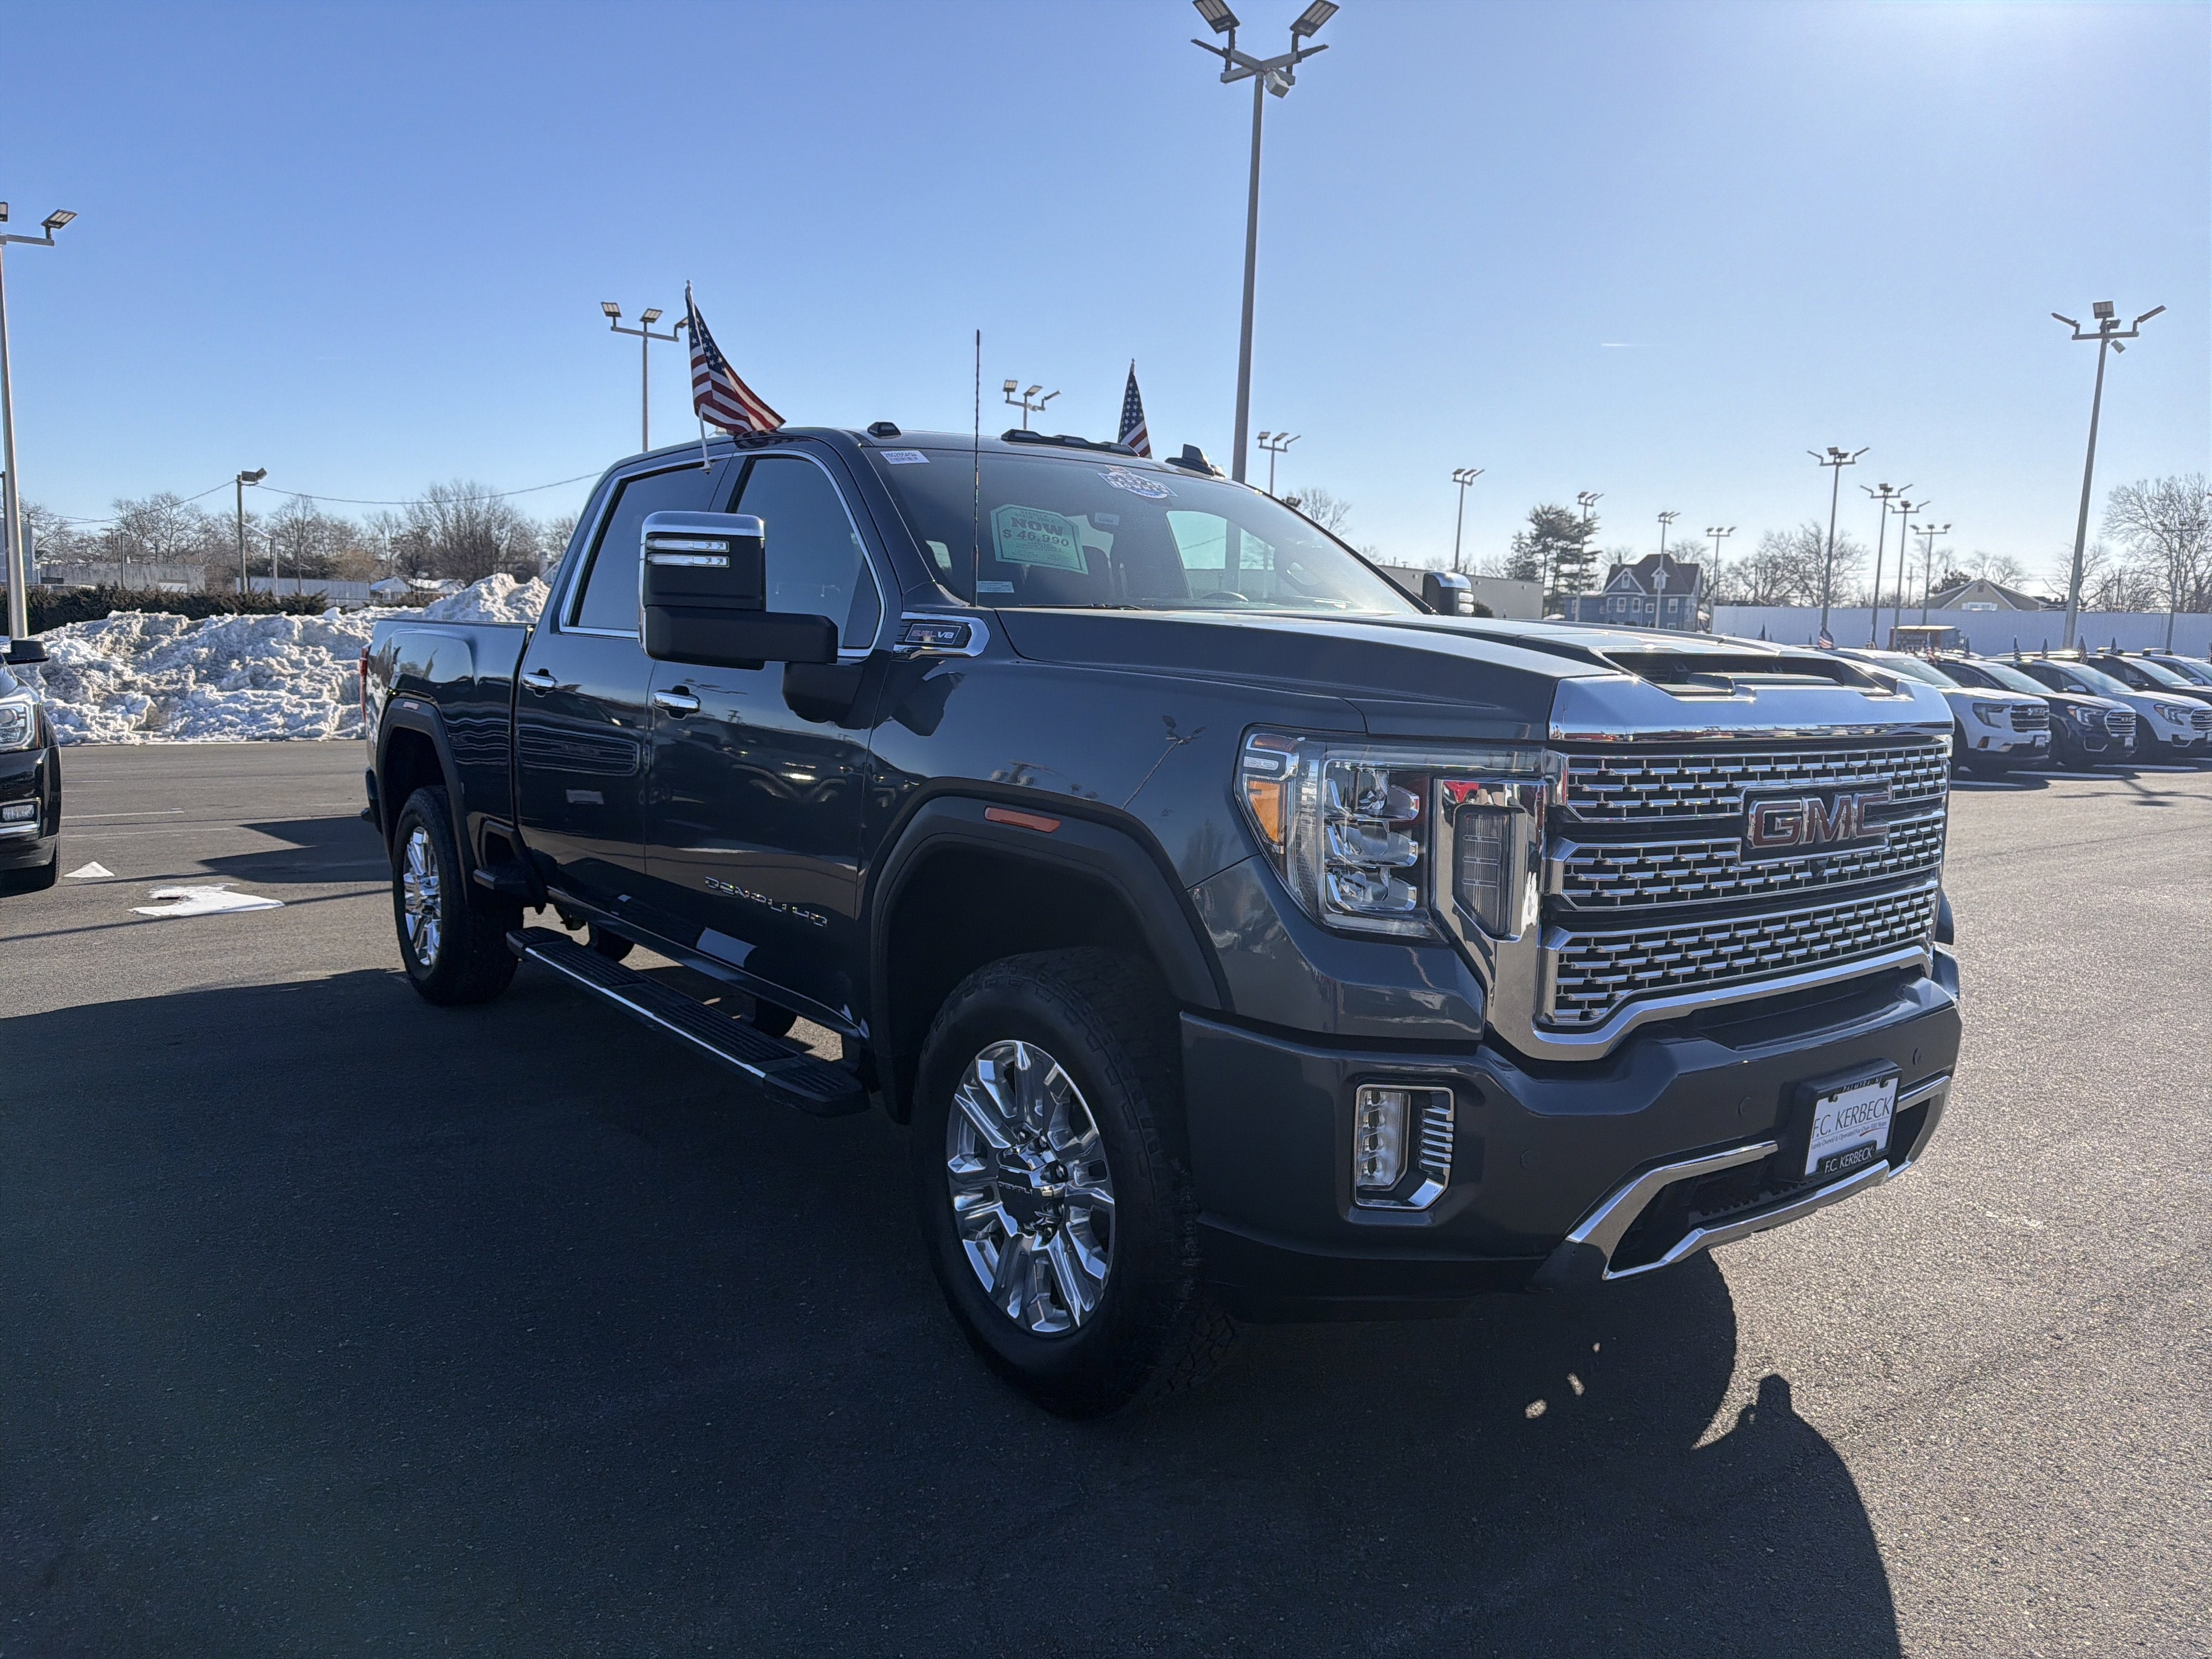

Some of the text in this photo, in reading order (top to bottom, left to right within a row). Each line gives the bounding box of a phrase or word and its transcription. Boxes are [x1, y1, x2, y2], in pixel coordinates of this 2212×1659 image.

[1011, 517, 1064, 537] NOW
[1017, 530, 1069, 546] 46,990
[1747, 792, 1891, 849] GMC
[1812, 1096, 1893, 1139] F.C. KERBECK
[1824, 1146, 1873, 1174] F.C. KERBECK
